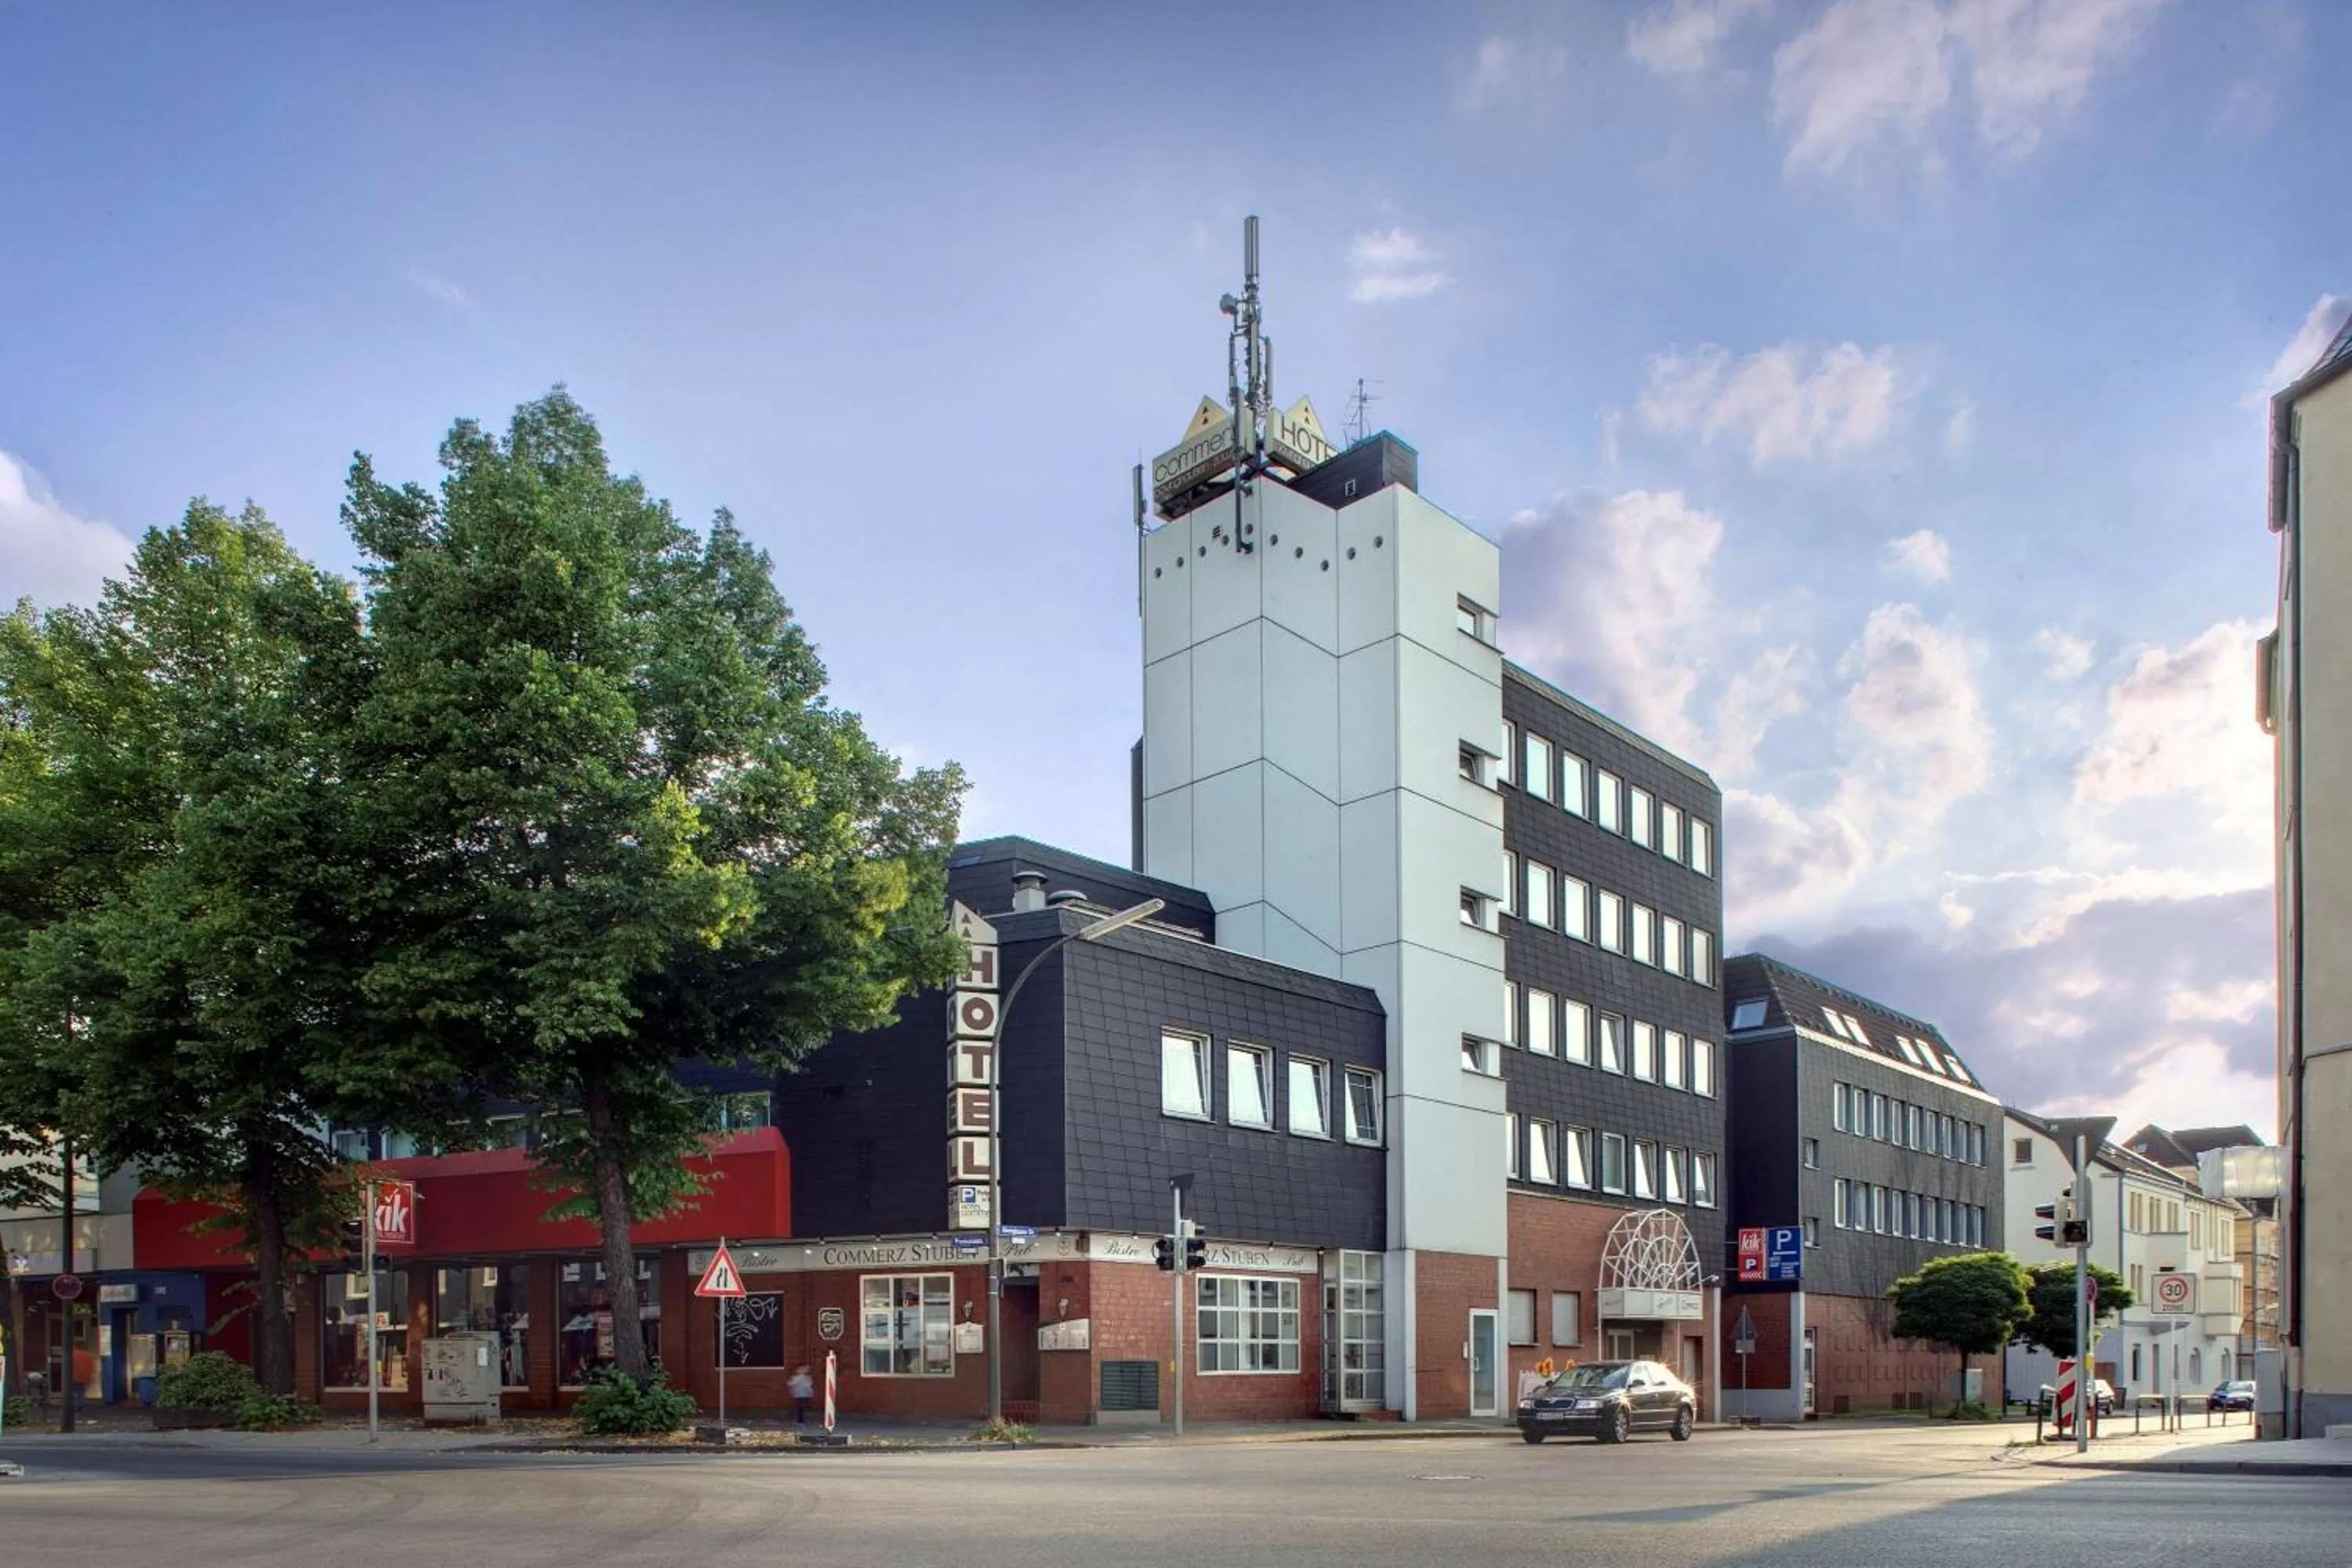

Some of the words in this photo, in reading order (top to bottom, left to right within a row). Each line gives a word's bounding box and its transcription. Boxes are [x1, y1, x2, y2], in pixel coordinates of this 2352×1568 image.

[1280, 414, 1340, 462] HOTE
[1155, 426, 1234, 482] commer
[961, 950, 995, 1175] HOTEL
[962, 1188, 975, 1203] P
[1103, 1240, 1141, 1256] Bistro
[1777, 1230, 1792, 1250] P
[1003, 1242, 1034, 1257] Pub
[2165, 1283, 2182, 1297] 30
